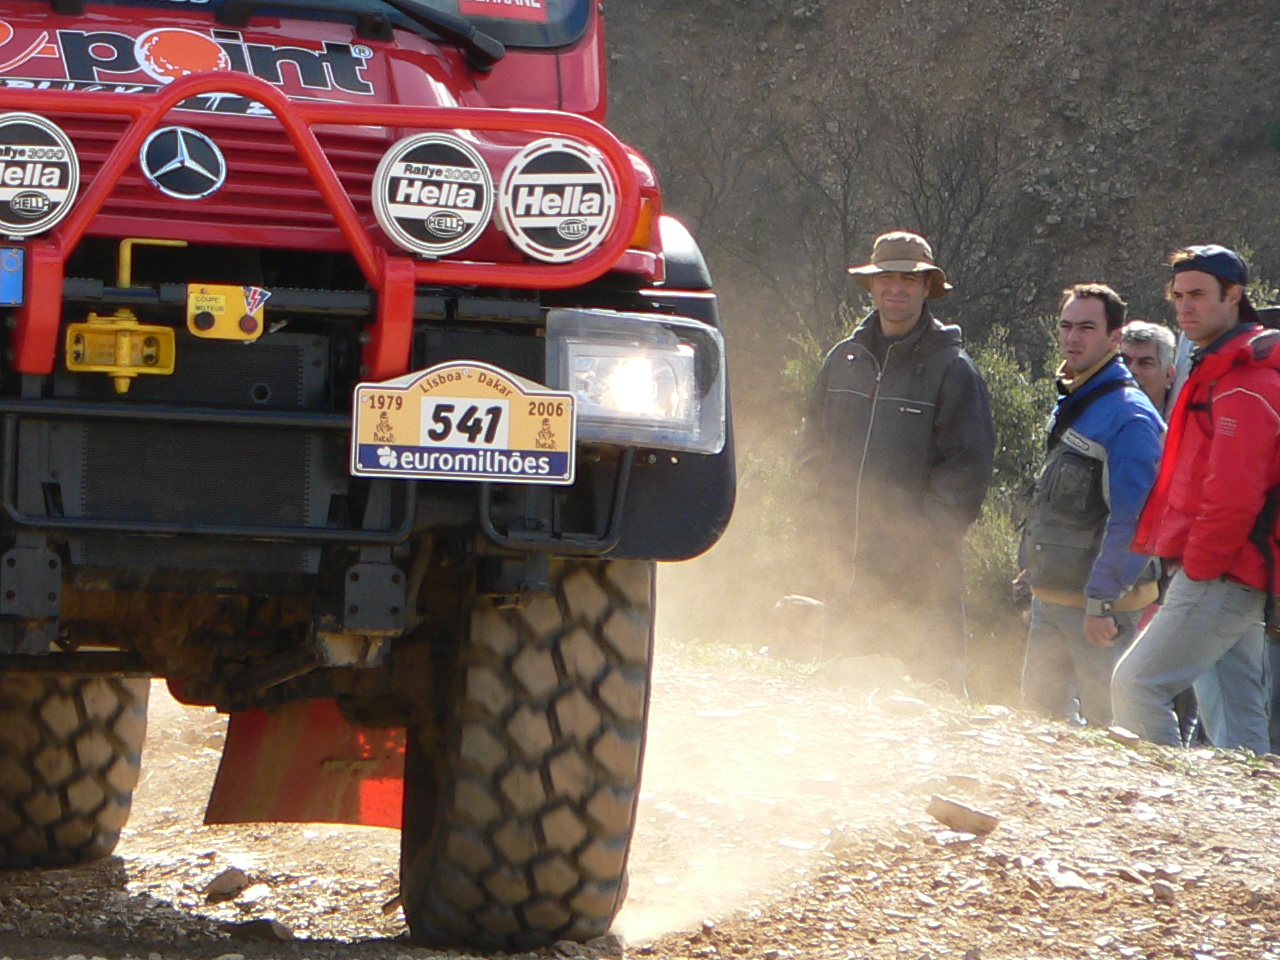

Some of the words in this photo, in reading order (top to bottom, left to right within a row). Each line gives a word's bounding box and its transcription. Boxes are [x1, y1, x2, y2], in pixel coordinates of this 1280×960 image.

[404, 163, 443, 180] Rallye
[12, 196, 52, 211] HELLA
[396, 179, 477, 209] Hella
[515, 186, 602, 216] Hella
[427, 216, 465, 232] HELLA
[420, 371, 463, 394] Lisboa
[477, 372, 513, 398] Dakar
[369, 394, 403, 411] 1979
[528, 401, 564, 418] 2006
[427, 403, 503, 444] 541
[400, 451, 551, 474] euromilhões
